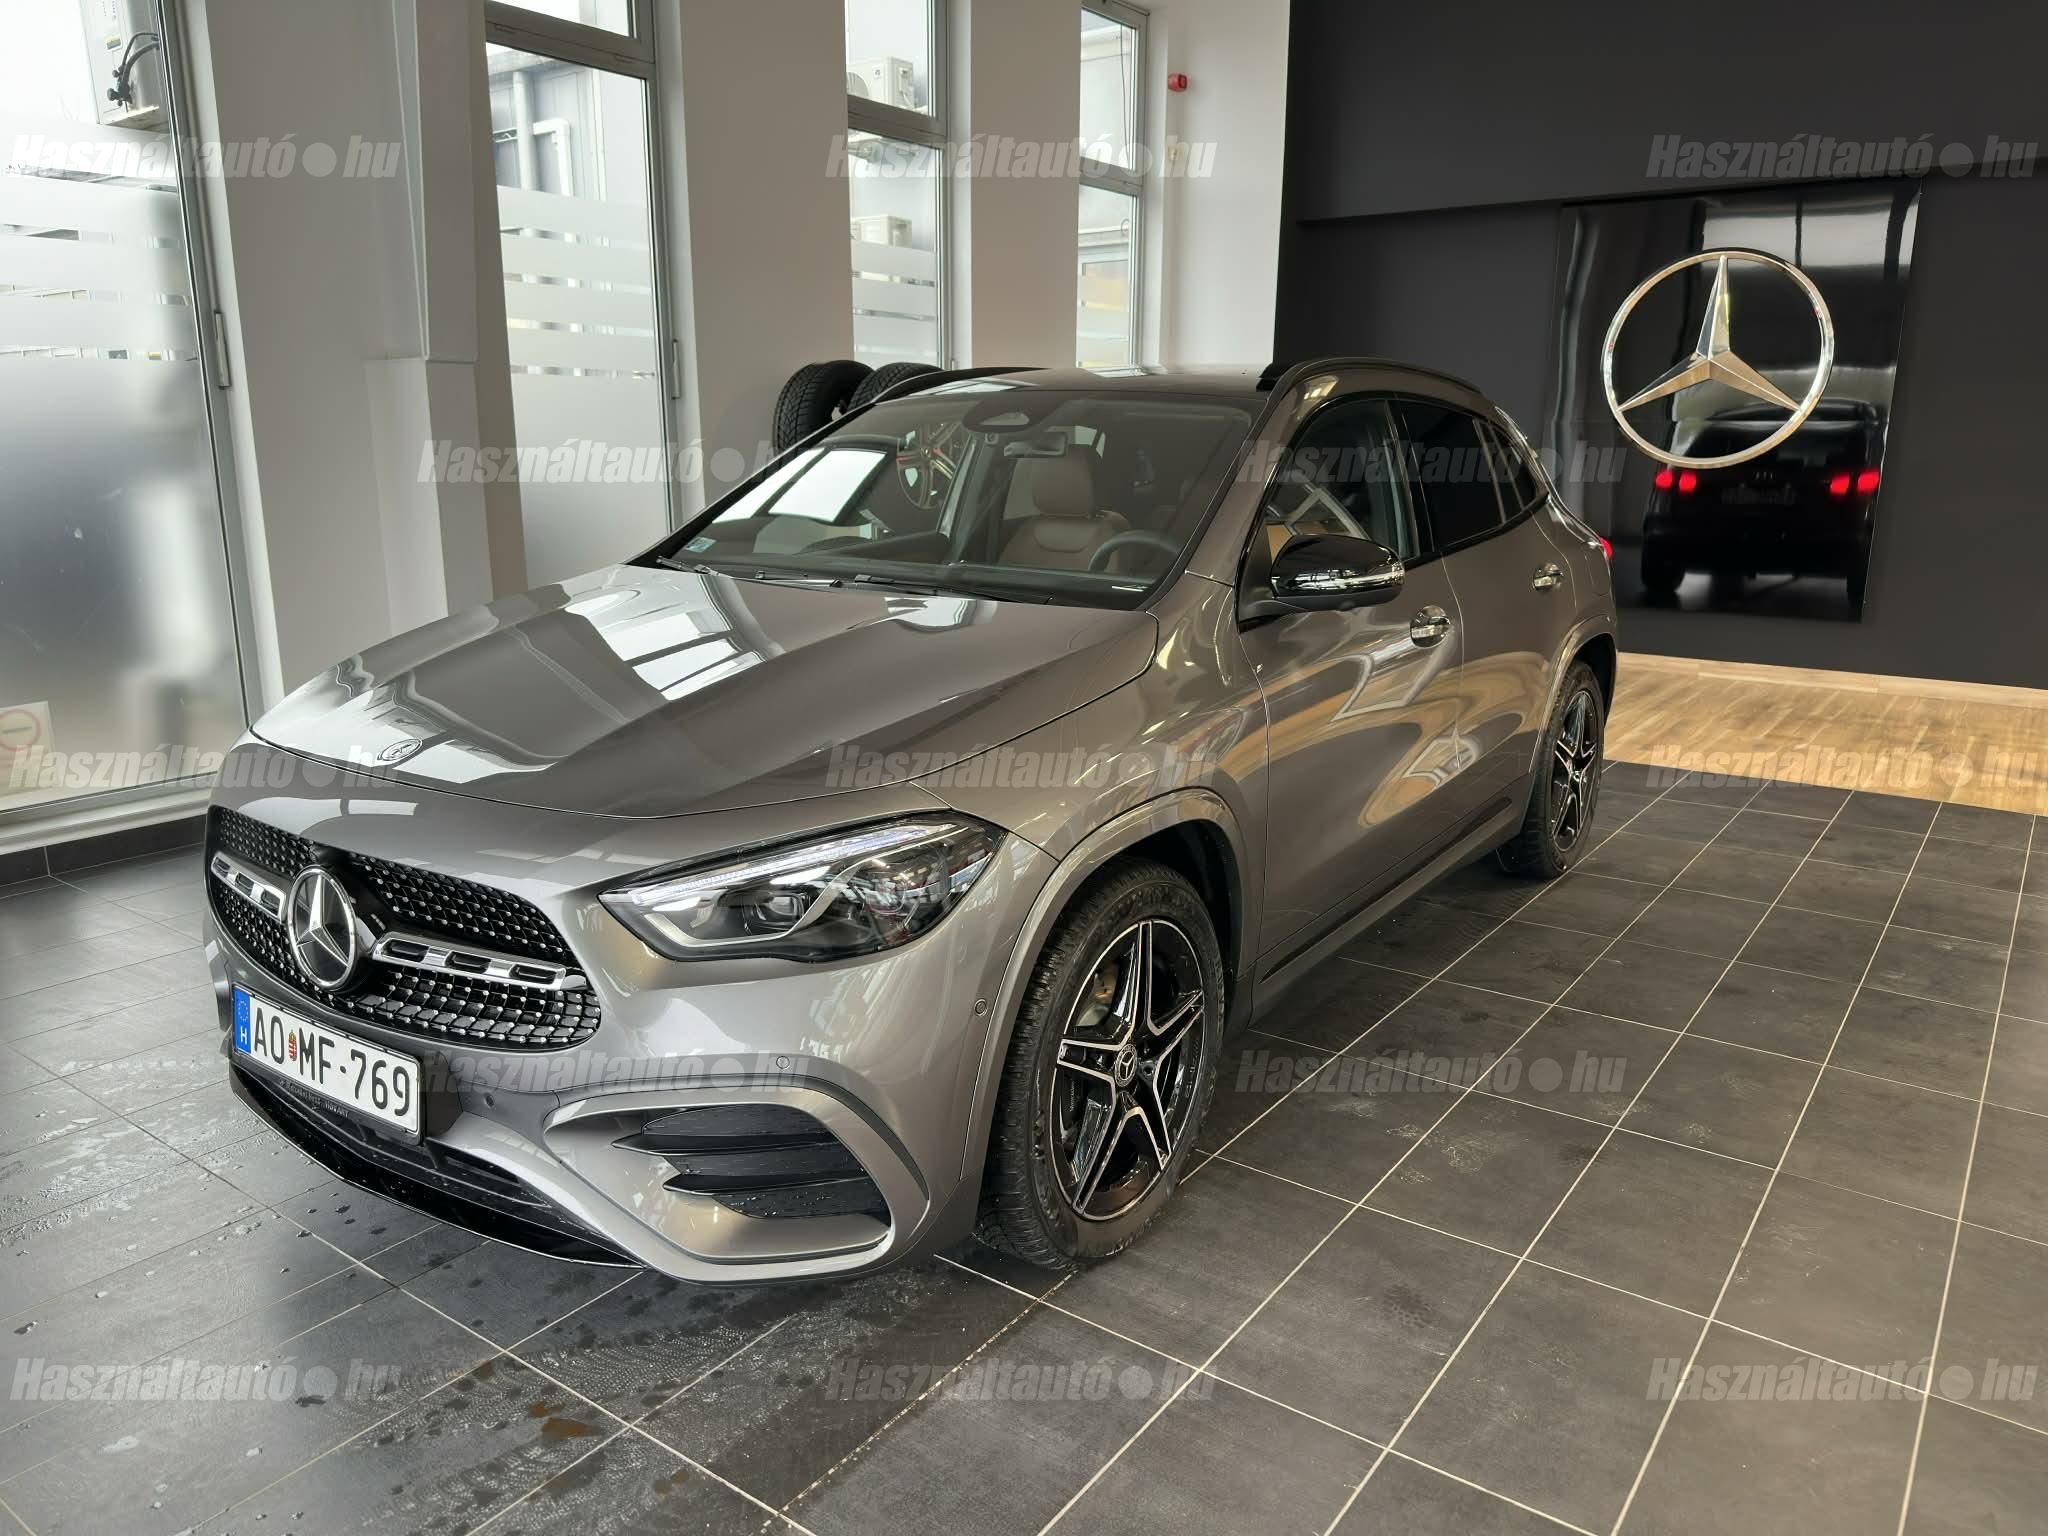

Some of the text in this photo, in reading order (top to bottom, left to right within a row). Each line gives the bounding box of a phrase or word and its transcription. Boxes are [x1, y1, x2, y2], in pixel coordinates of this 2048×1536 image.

[239, 1025, 248, 1045] H
[254, 1007, 285, 1065] AO
[299, 1027, 410, 1117] MF-769
